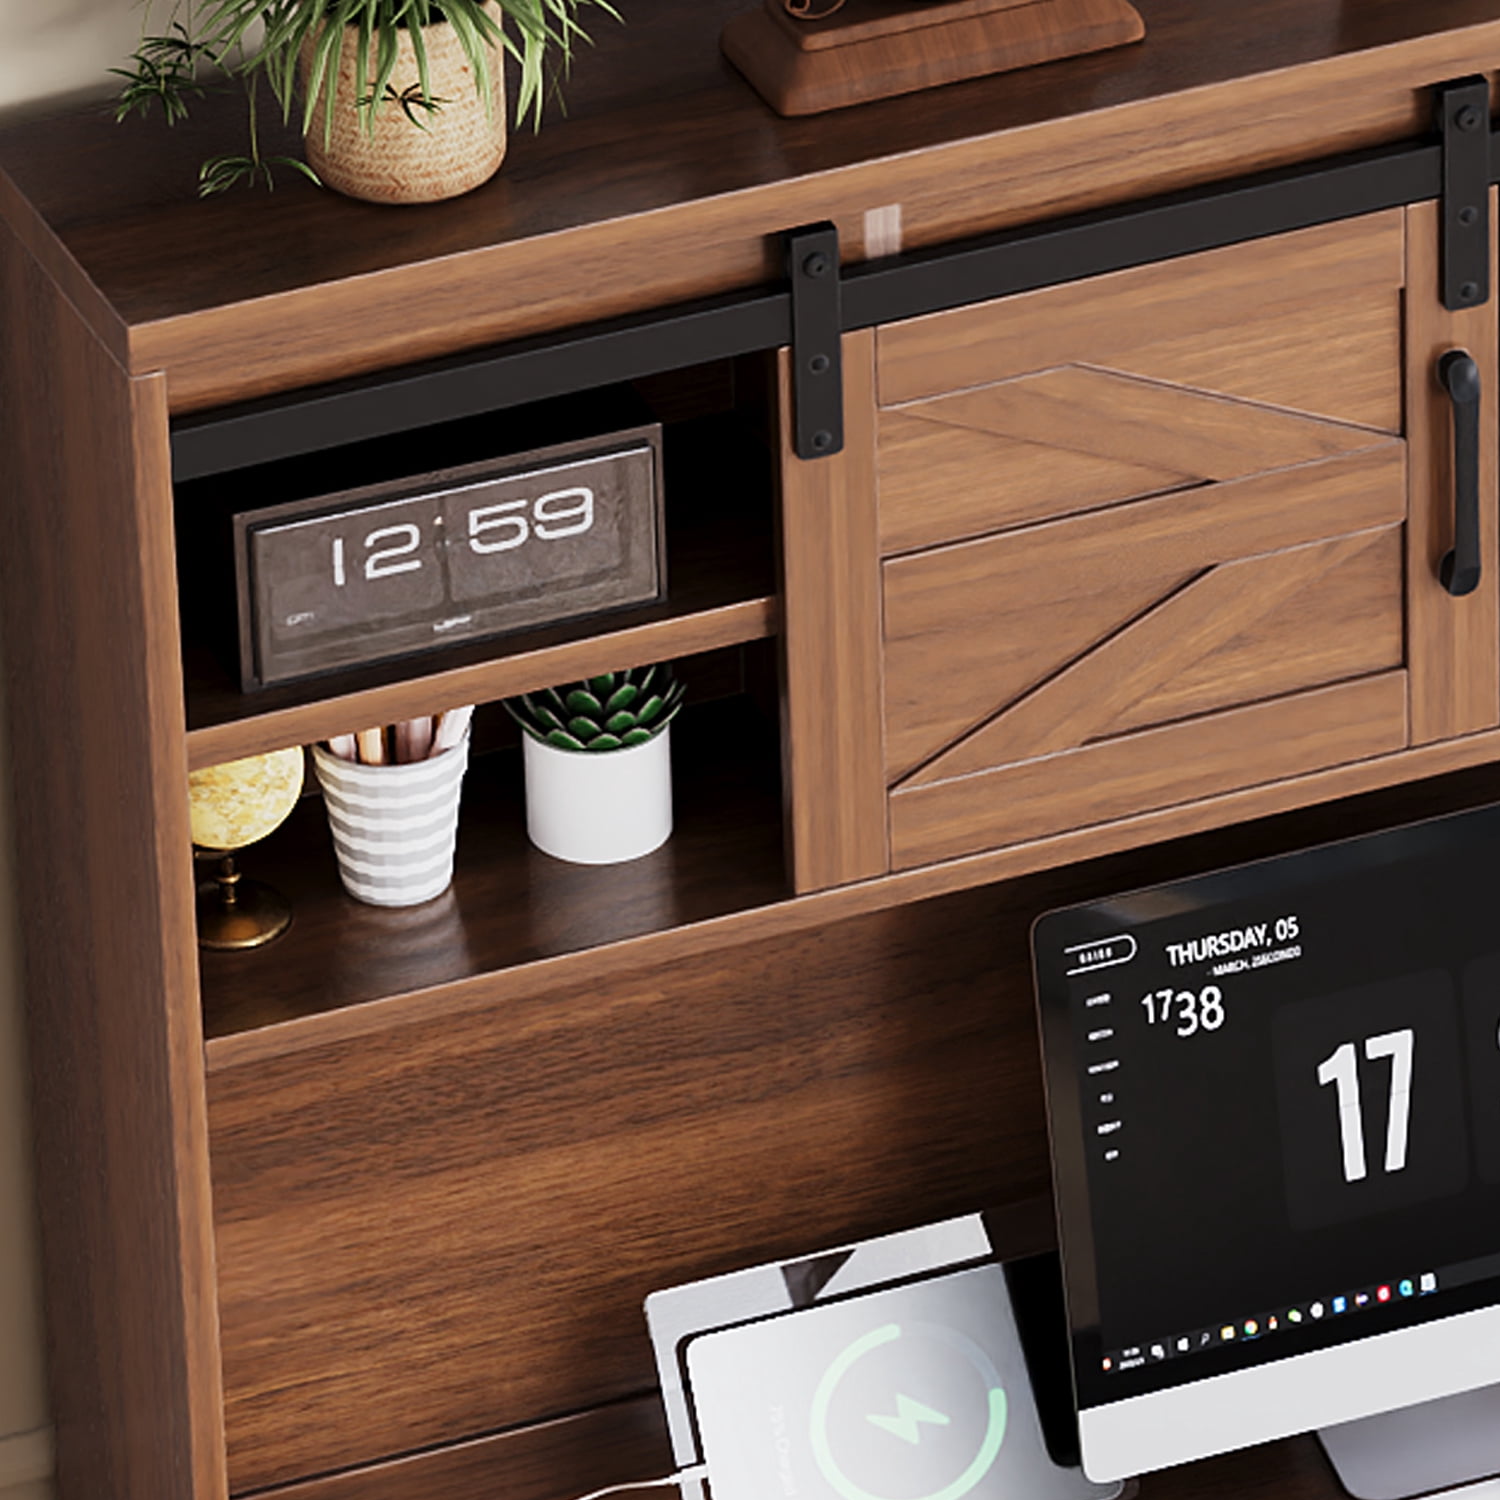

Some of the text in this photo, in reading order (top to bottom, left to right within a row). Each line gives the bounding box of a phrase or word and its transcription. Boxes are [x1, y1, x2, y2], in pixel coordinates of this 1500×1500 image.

[1166, 922, 1273, 967] THURSDAY,
[1275, 916, 1300, 941] 05
[1317, 1028, 1414, 1182] 17
